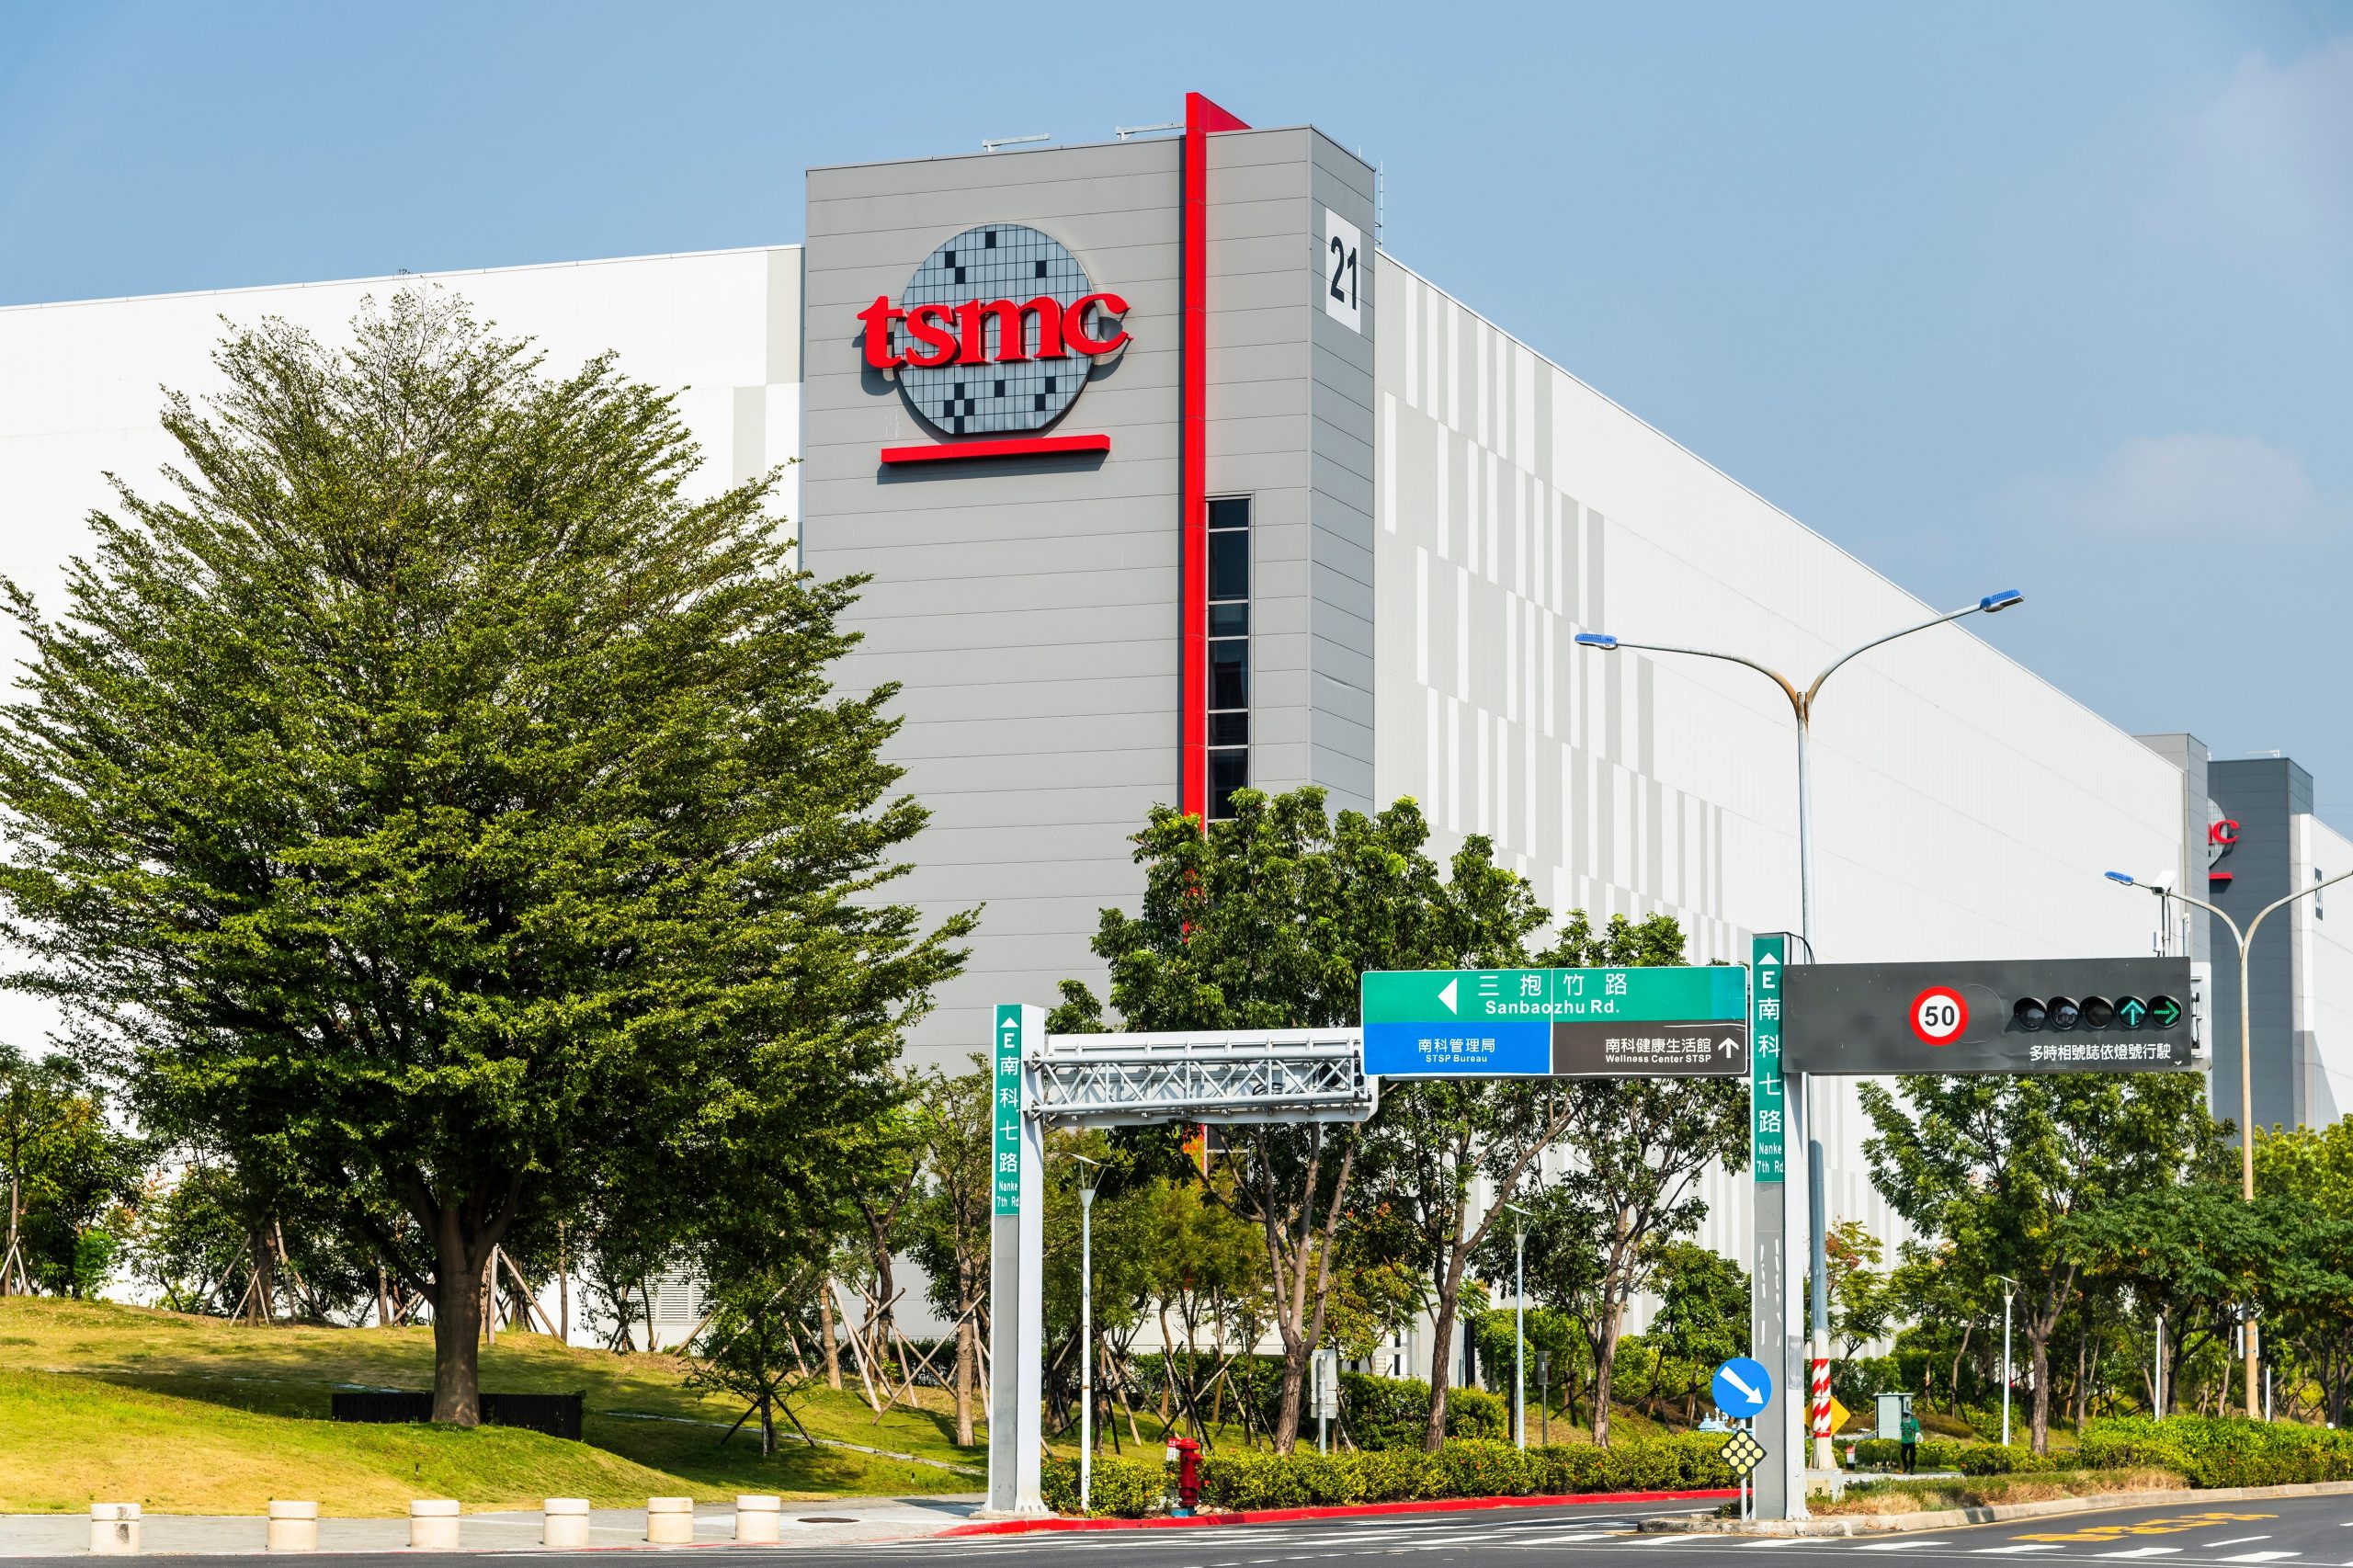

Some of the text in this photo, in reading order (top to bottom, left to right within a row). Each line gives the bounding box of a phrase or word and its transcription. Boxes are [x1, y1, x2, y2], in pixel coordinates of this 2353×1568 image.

[1330, 235, 1357, 311] 21
[857, 293, 1133, 369] tsmc
[1478, 972, 1628, 997] 三抱竹路
[1762, 971, 1776, 989] E
[1485, 999, 1620, 1015] Sanbaozhu Rd.
[1924, 1005, 1955, 1028] 50
[1004, 1033, 1015, 1049] E
[1417, 1038, 1495, 1053] 南科管理局
[1605, 1038, 1711, 1053] 南科健康生活館
[1426, 1054, 1487, 1062] STSP Bureau
[1605, 1054, 1711, 1063] Wellness Center STSP
[1757, 997, 1781, 1134] 南科七路
[999, 1056, 1019, 1174] 南科七路
[1758, 1142, 1782, 1155] Nanke
[1756, 1160, 1770, 1174] 7th
[998, 1180, 1018, 1192] Nanke
[996, 1196, 1008, 1208] 7th
